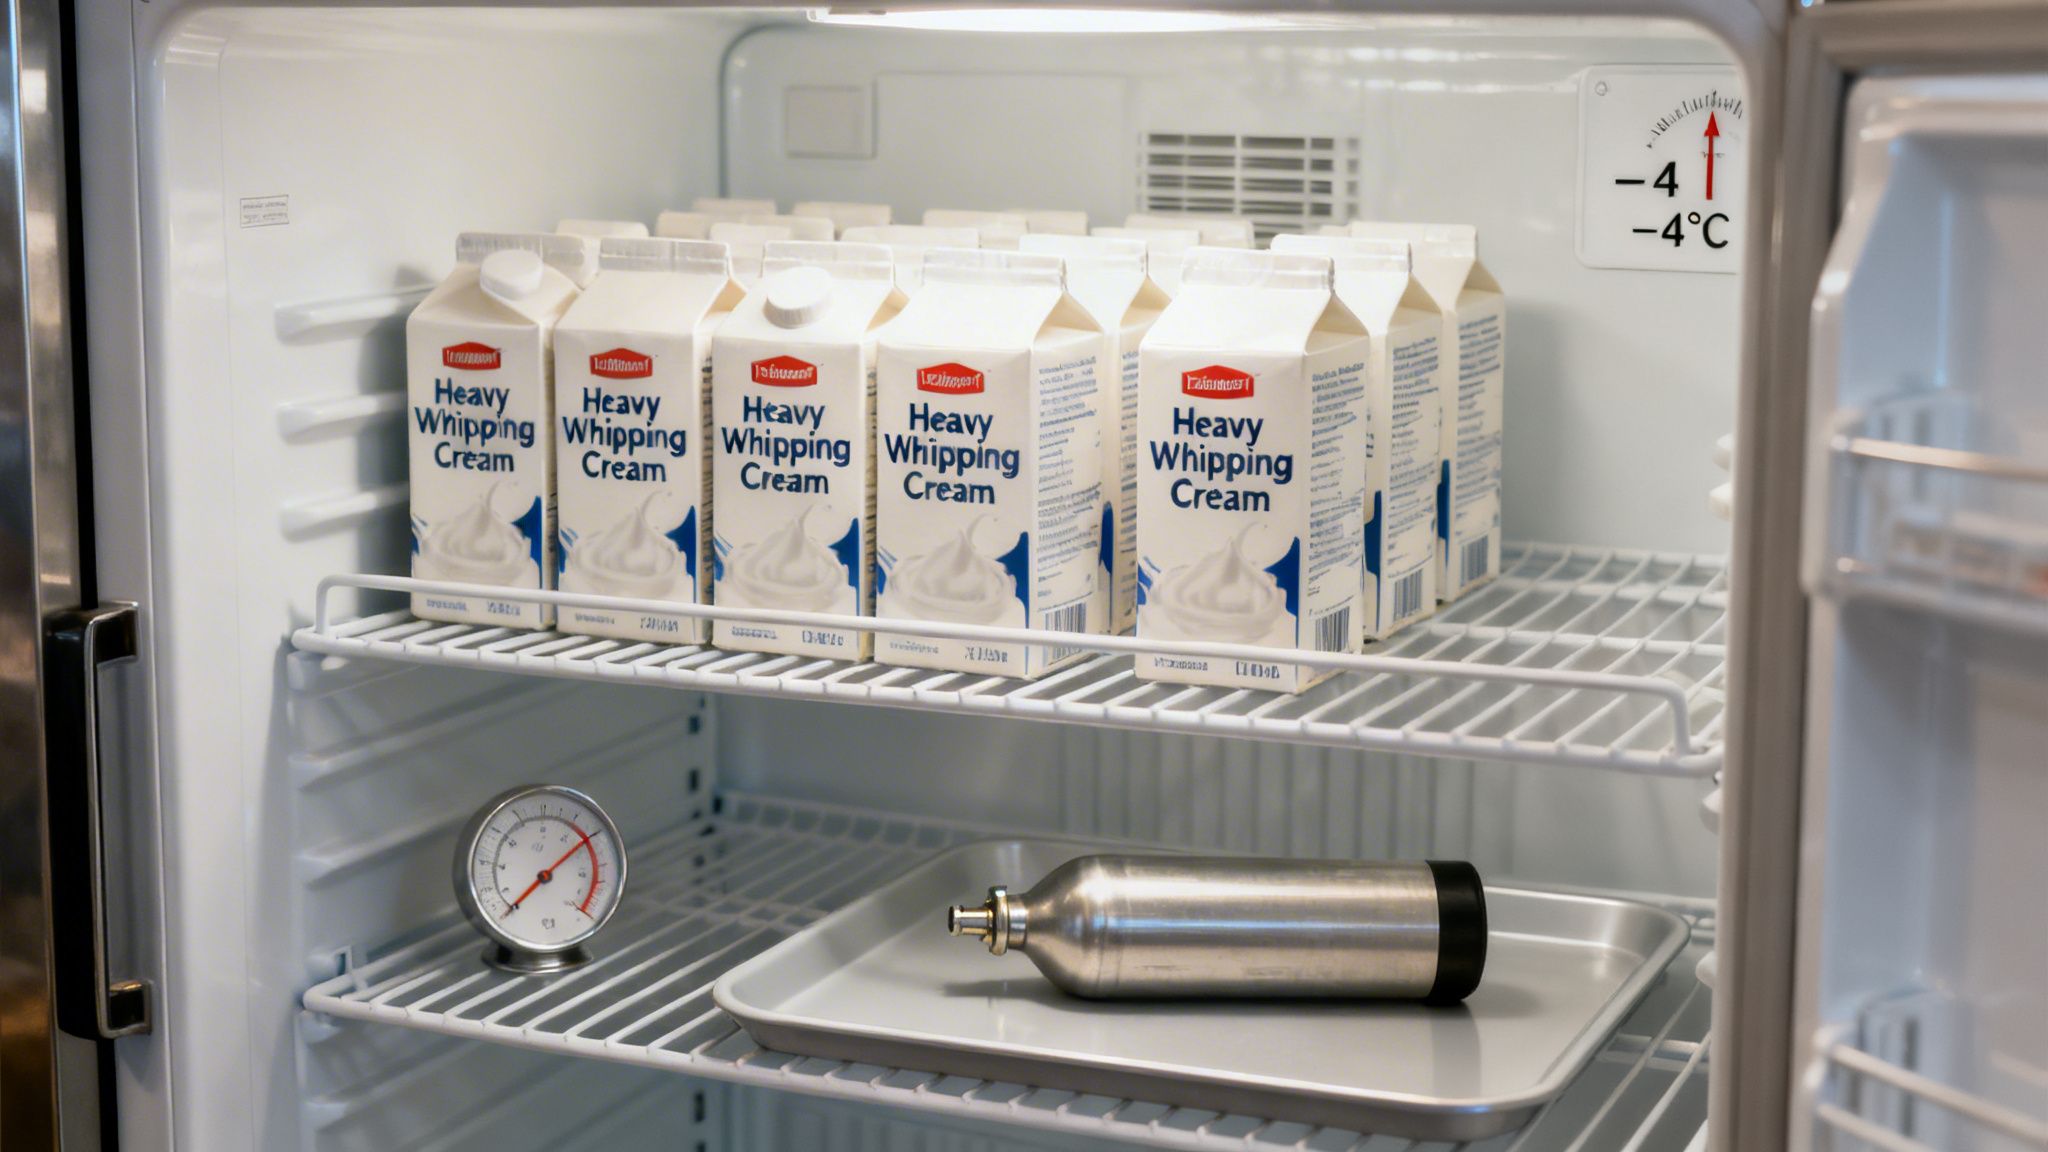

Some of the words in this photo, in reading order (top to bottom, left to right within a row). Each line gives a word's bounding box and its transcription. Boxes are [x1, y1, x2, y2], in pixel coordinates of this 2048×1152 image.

[1632, 211, 1729, 249] -4°C
[435, 377, 510, 413] Heavy
[583, 387, 660, 421] Heavy
[744, 396, 825, 429] Heavy
[414, 407, 535, 448] Whipping
[562, 416, 686, 457] Whipping
[909, 403, 993, 443] Heavy
[1173, 407, 1263, 446] Heavy
[434, 441, 514, 472] Cream
[721, 427, 850, 467] Whipping
[885, 434, 1020, 479] Whipping
[1150, 441, 1293, 485] Whipping
[582, 450, 666, 482] Cream
[740, 462, 829, 494] Cream
[904, 471, 995, 504] Cream
[1171, 478, 1270, 511] Cream
